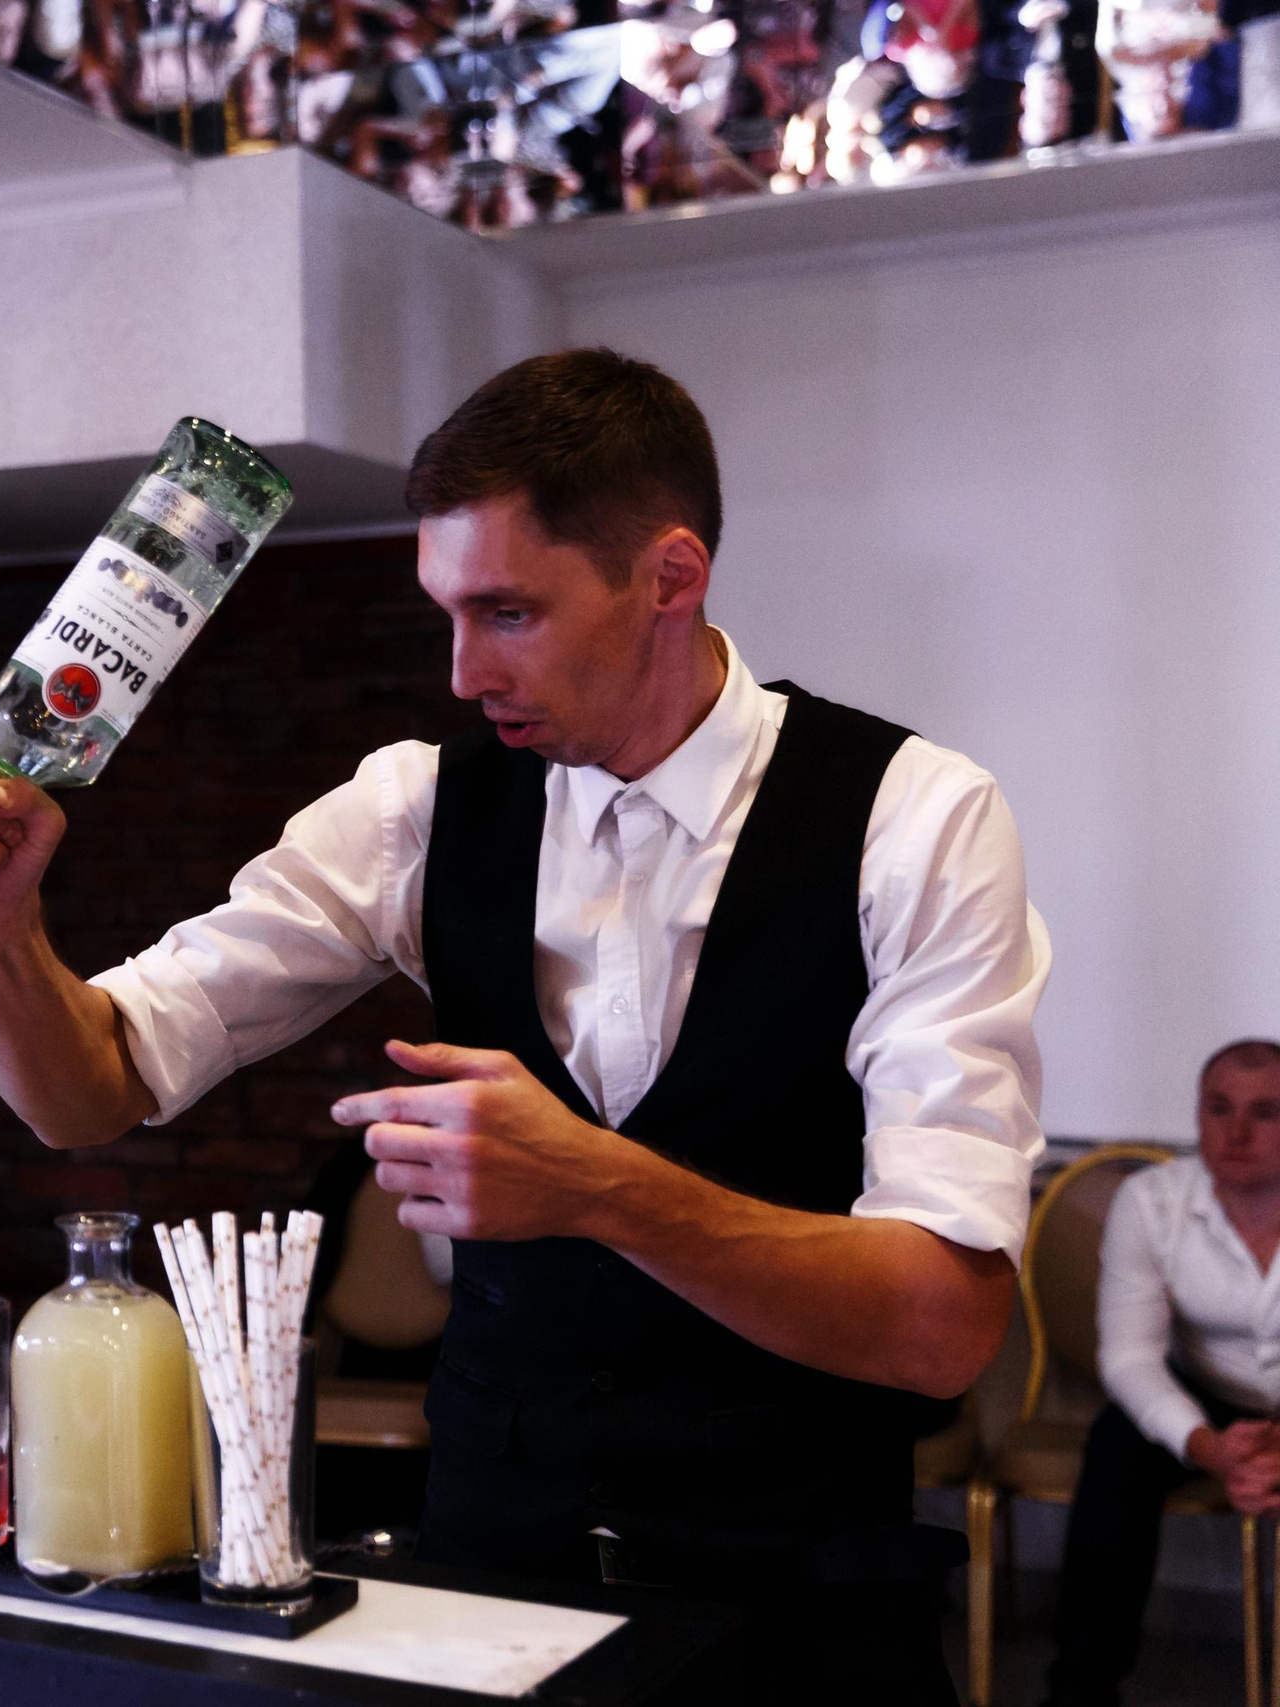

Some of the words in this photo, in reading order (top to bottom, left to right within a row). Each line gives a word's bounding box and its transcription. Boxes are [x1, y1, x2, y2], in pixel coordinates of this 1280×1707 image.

[77, 603, 118, 634] BLANCA
[44, 614, 147, 694] BACARDÍ
[120, 632, 152, 660] CARTA
